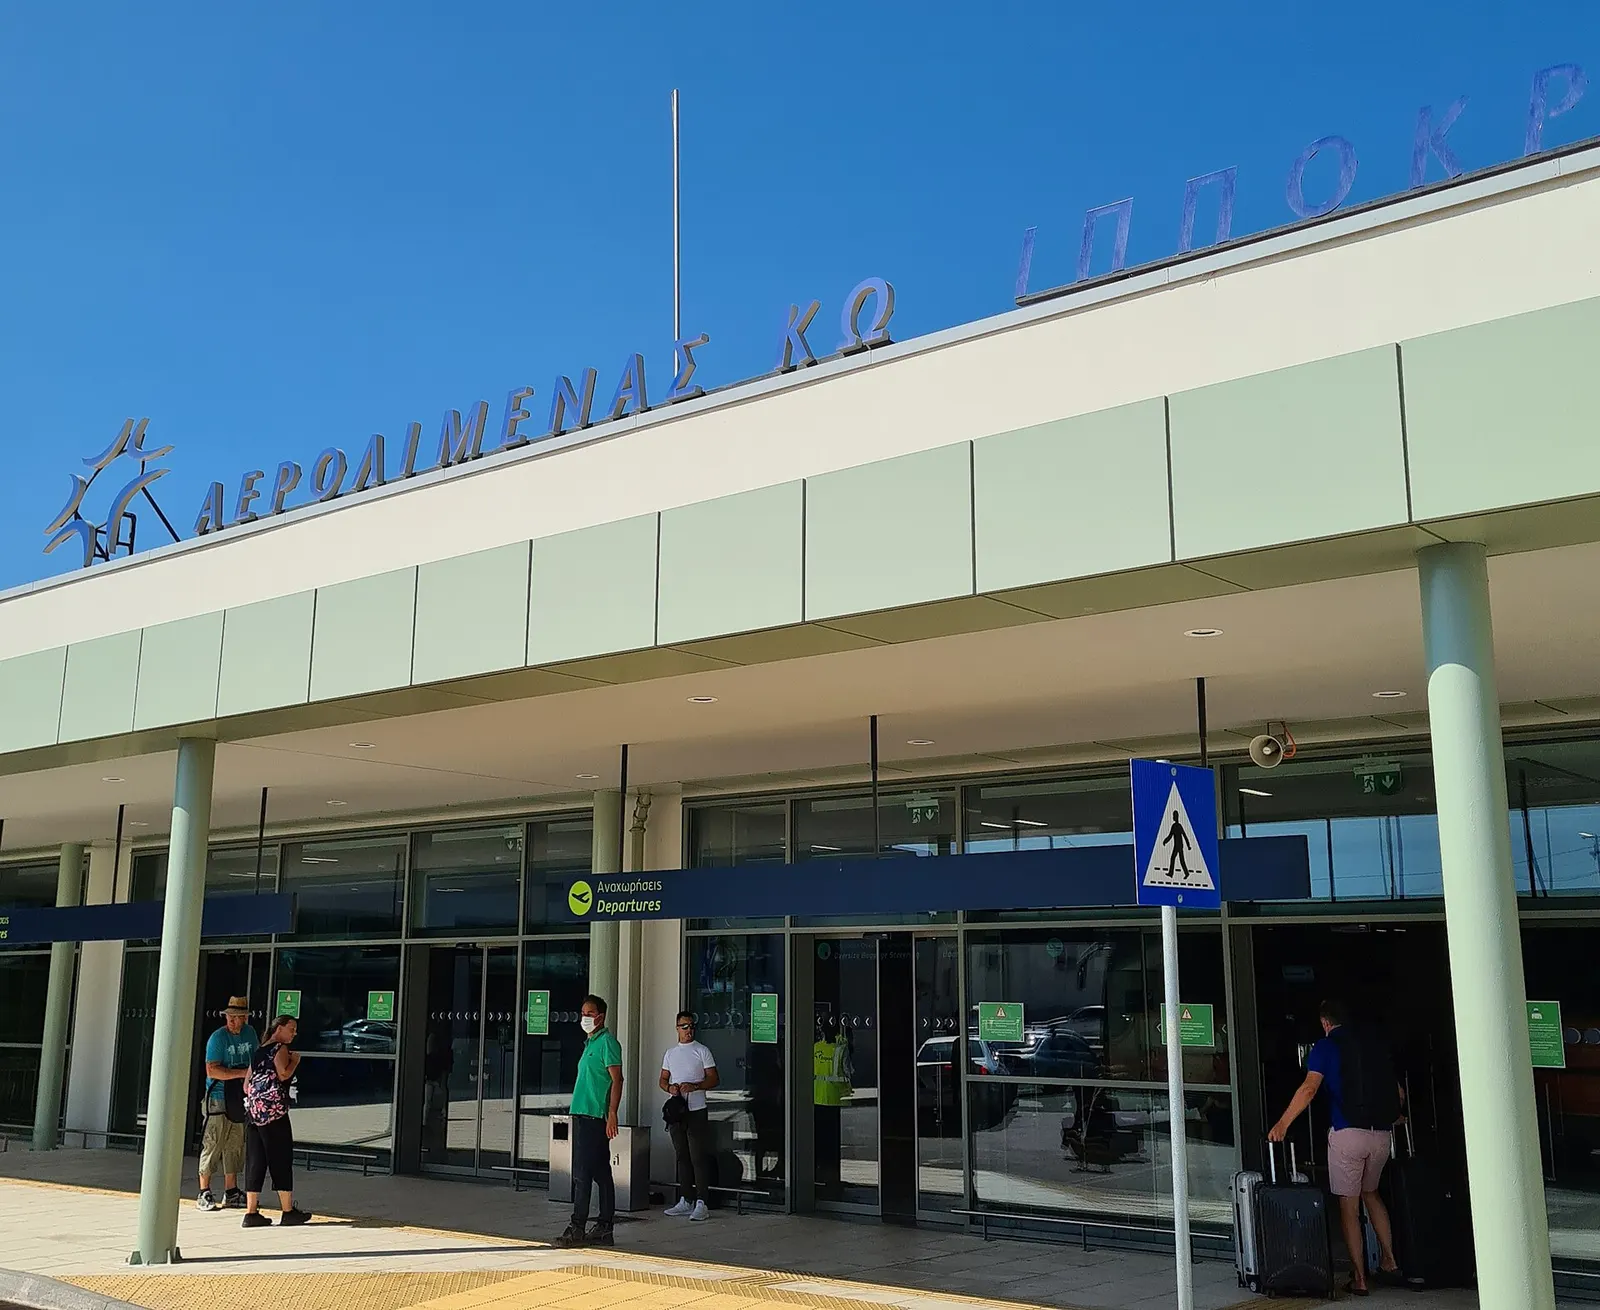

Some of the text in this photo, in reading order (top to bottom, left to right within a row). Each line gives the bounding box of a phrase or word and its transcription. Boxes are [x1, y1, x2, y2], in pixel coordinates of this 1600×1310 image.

[1015, 63, 1588, 298] ΙΠΠΟΚΡ
[194, 277, 897, 535] ΑΕΡΟΛΙΜΕΝΑΣ ΚΩ
[597, 879, 663, 894] Αναχωρήσεις
[597, 899, 661, 915] Departures
